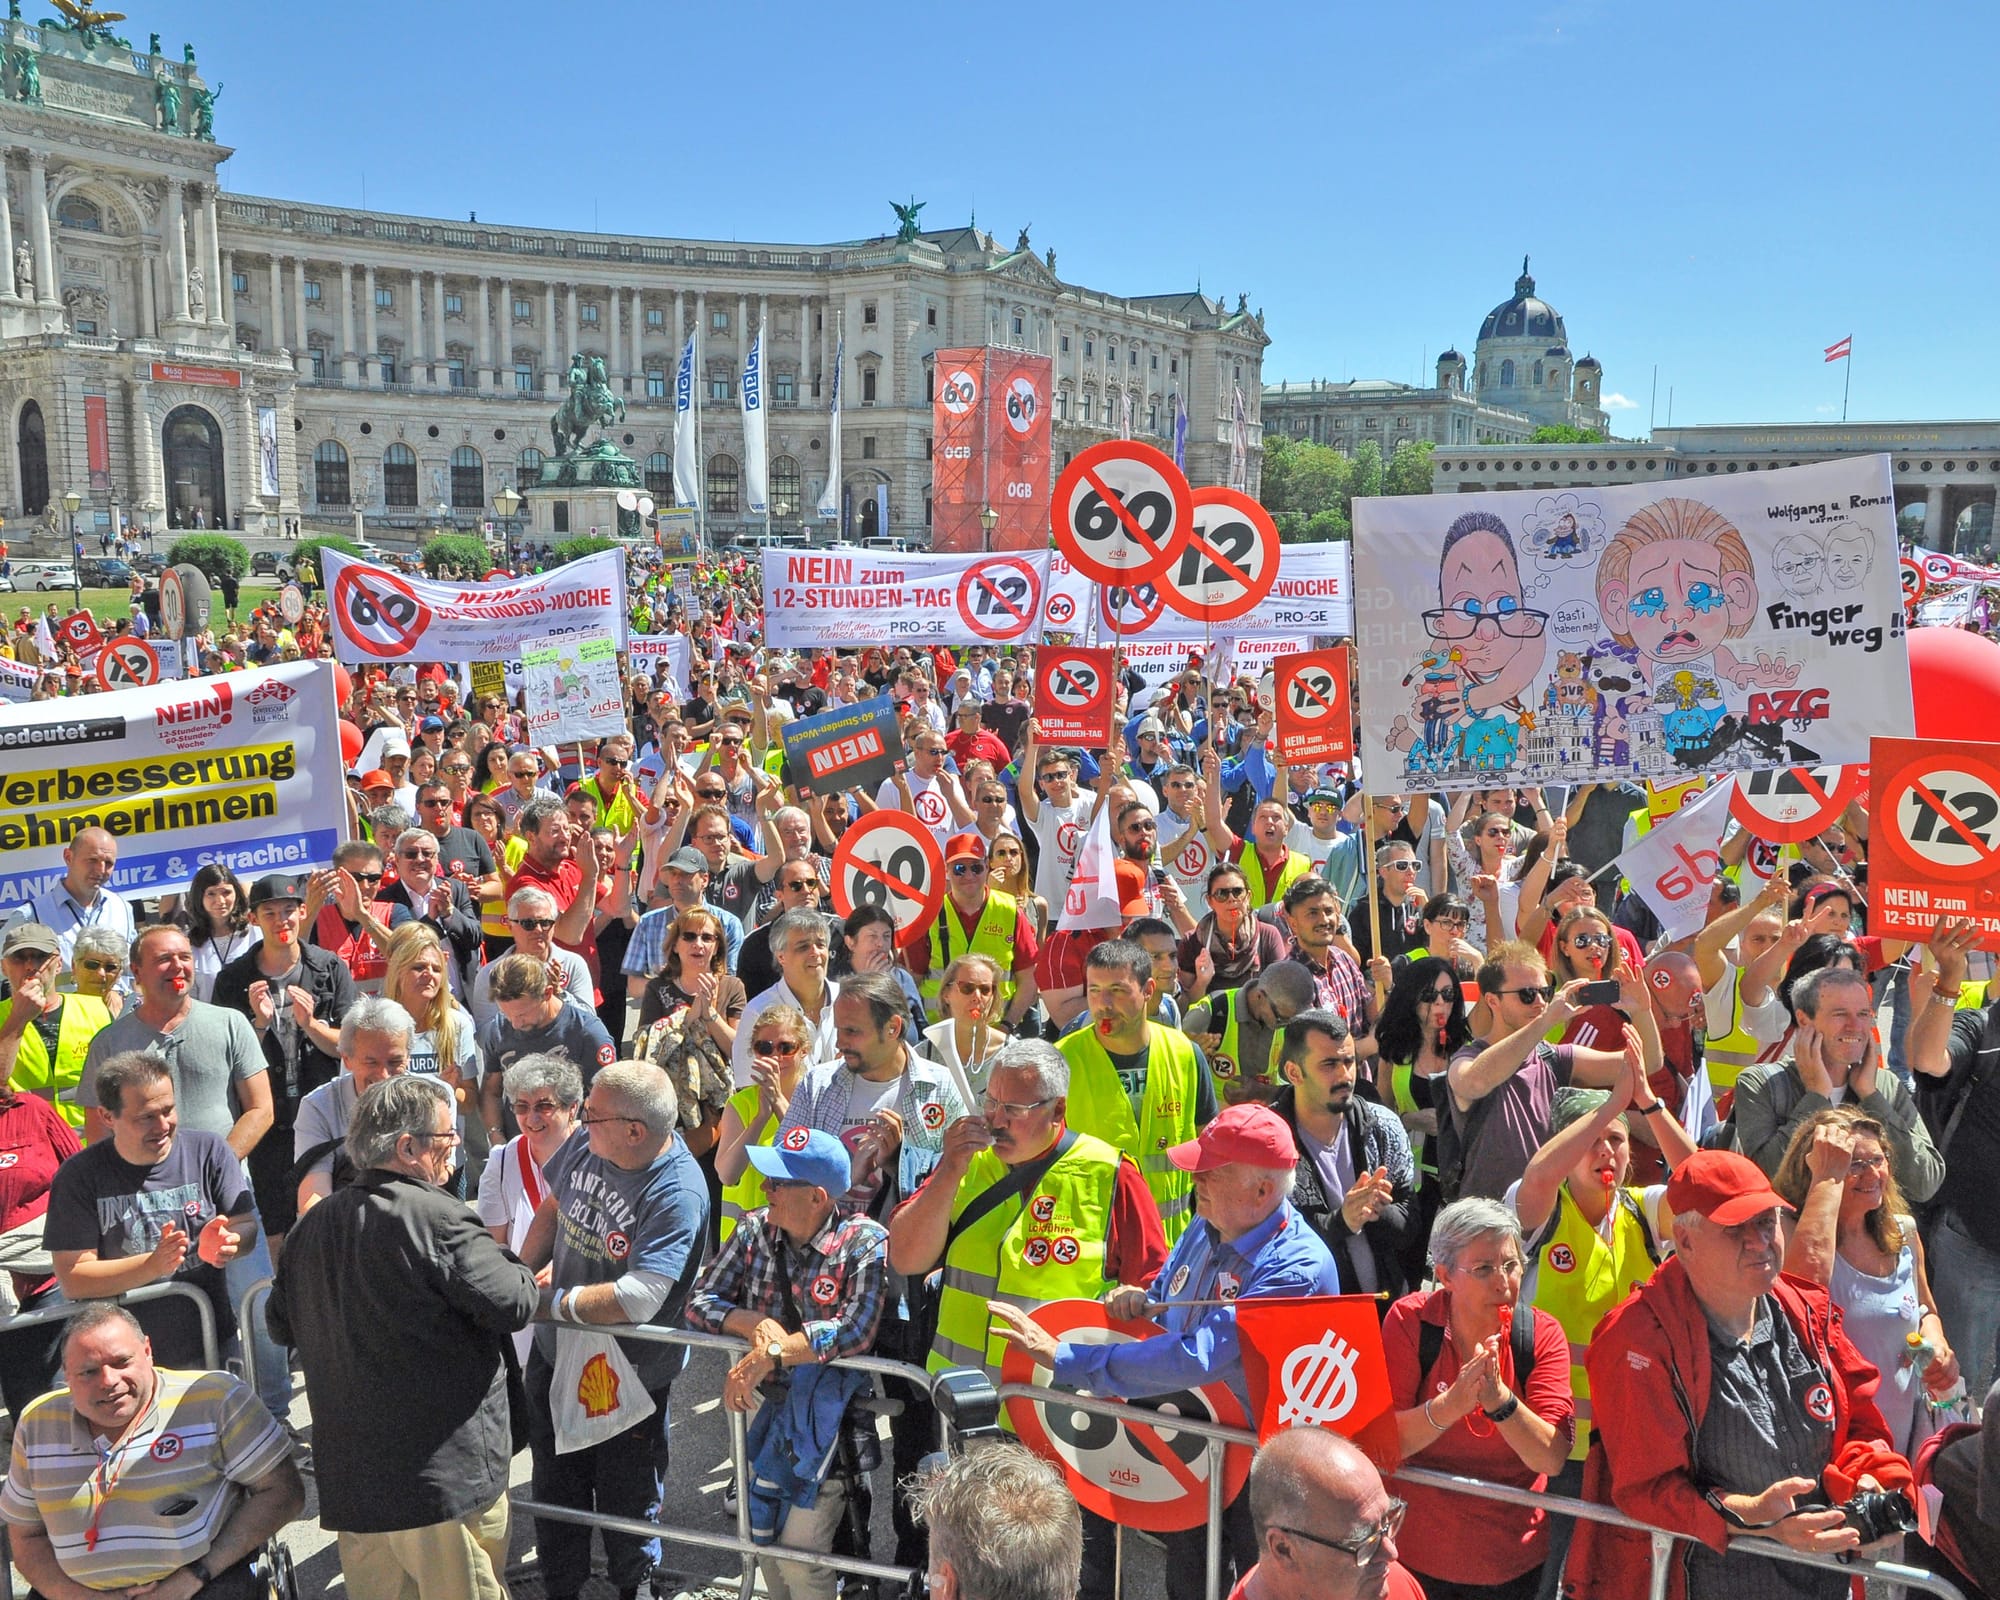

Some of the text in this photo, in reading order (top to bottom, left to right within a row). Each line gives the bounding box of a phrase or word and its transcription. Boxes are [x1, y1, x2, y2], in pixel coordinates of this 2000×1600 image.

[944, 382, 974, 404] 60
[1008, 392, 1035, 419] 60
[1074, 486, 1172, 545] 60
[1767, 504, 1827, 522] Wolfgang
[1850, 495, 1893, 509] Roman
[1809, 514, 1849, 524] warnen:
[1108, 548, 1127, 558] vida
[1178, 521, 1255, 586] 12
[788, 557, 905, 585] NEIN zum
[454, 588, 521, 604] NEIN
[772, 587, 951, 609] 12-STUNDEN-TAG
[975, 576, 1028, 615] 12
[1207, 590, 1225, 600] vida
[351, 586, 416, 627] 60
[1050, 603, 1071, 616] 60
[1766, 600, 1864, 637] Finger
[1239, 640, 1300, 653] Grenzen.
[1829, 622, 1883, 653] weg
[109, 653, 149, 683] 12
[1056, 669, 1095, 695] 12
[1561, 684, 1584, 697] JVR
[1294, 675, 1332, 708] 12
[155, 682, 233, 727] NEIN!
[589, 699, 621, 713] vida
[1749, 688, 1830, 725] AZG
[528, 710, 560, 724] vida
[788, 707, 890, 743] zur 60-Stunden-Woche
[1042, 718, 1064, 728] NEIN
[159, 722, 222, 739] 12-Stunden-Tag
[165, 731, 216, 745] 60-Stunden-
[1042, 729, 1103, 738] 12-STUNDEN-TAG
[177, 740, 205, 750] Woche
[1284, 735, 1323, 747] NEIN zum
[1285, 741, 1344, 759] 12-STUNDEN-TAG
[812, 732, 879, 773] NEIN
[923, 799, 940, 819] 12
[1779, 805, 1797, 816] vida
[1911, 789, 1999, 846] 12
[166, 857, 188, 879] &
[197, 838, 309, 872] Strache!
[853, 845, 925, 908] 60
[1884, 888, 1967, 911] NEIN zum
[984, 921, 1004, 934] vida
[1884, 909, 2000, 932] 12-STUDEN-TA
[1215, 1059, 1231, 1073] 12
[789, 1132, 806, 1147] 12
[570, 1170, 602, 1200] SANTA
[606, 1191, 637, 1231] CRUZ
[1037, 1201, 1054, 1215] 12
[1029, 1223, 1075, 1234] Lokführer
[612, 1239, 626, 1252] 12
[1029, 1244, 1047, 1259] 12
[1056, 1242, 1076, 1259] 12
[1554, 1250, 1572, 1265] 12
[817, 1280, 835, 1296] 12
[156, 1438, 178, 1457] 12
[1109, 1466, 1141, 1485] vida
